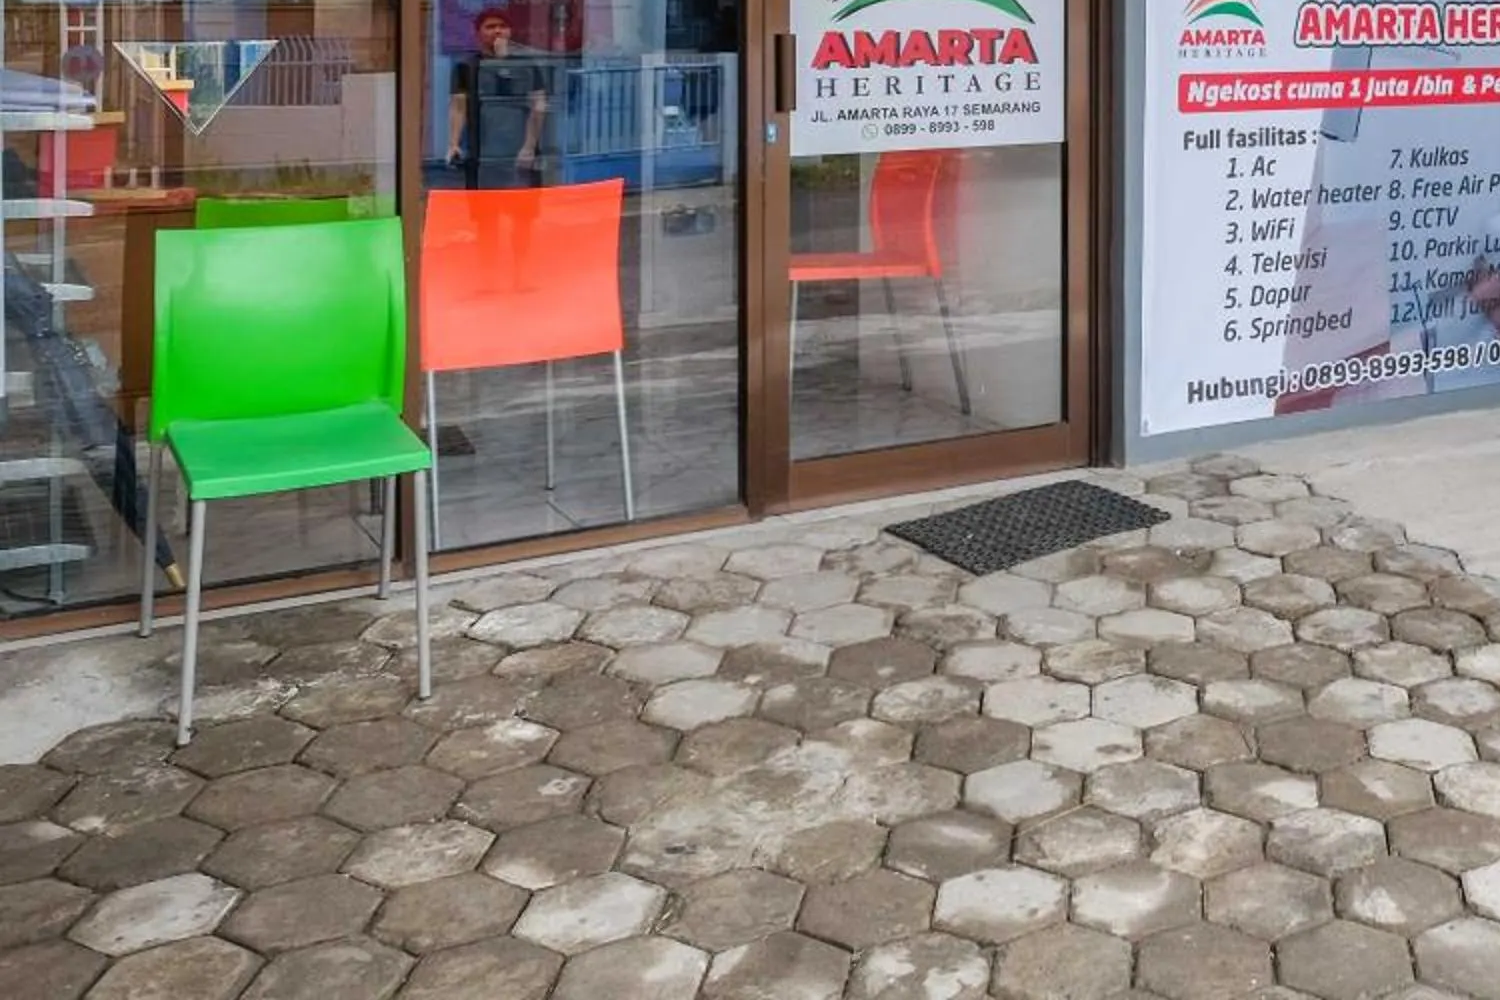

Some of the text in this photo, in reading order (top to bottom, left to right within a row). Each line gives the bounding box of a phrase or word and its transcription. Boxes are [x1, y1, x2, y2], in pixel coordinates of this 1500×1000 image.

[1299, 4, 1439, 44] AMARTA
[810, 28, 1039, 69] AMARTA
[1179, 29, 1266, 46] AMARTA
[1178, 48, 1267, 58] HERITAGE
[816, 71, 1041, 98] HERITAGE
[1187, 78, 1283, 107] Ngekost
[1287, 83, 1343, 101] cuma
[1347, 78, 1361, 98] 1
[1461, 75, 1476, 94] &
[811, 100, 1041, 123] JL. AMARTA RAYA 17 SEMARANG
[884, 122, 917, 136] 0899
[972, 119, 996, 132] 598
[1183, 130, 1221, 150] Full
[1227, 127, 1307, 148] fasilitas
[1226, 155, 1277, 179] 1. Ac
[1390, 147, 1469, 169] 7. Kulkas
[1225, 183, 1382, 211] 2. Water heater
[1388, 179, 1405, 200] 8.
[1412, 178, 1453, 199] Free
[1457, 174, 1484, 195] Air
[1225, 218, 1295, 244] 3. WiFi
[1388, 206, 1459, 231] 9. CCTV
[1388, 240, 1418, 261] 10.
[1425, 236, 1480, 259] Parkir
[1224, 248, 1328, 276] 4. Televisi
[1389, 271, 1420, 293] 11.
[1224, 285, 1311, 309] 5. Dapur
[1223, 308, 1353, 343] 6. Springbed
[1389, 302, 1418, 324] 12.
[1187, 369, 1285, 404] Hubungi
[1303, 348, 1470, 388] 0899-8993-598
